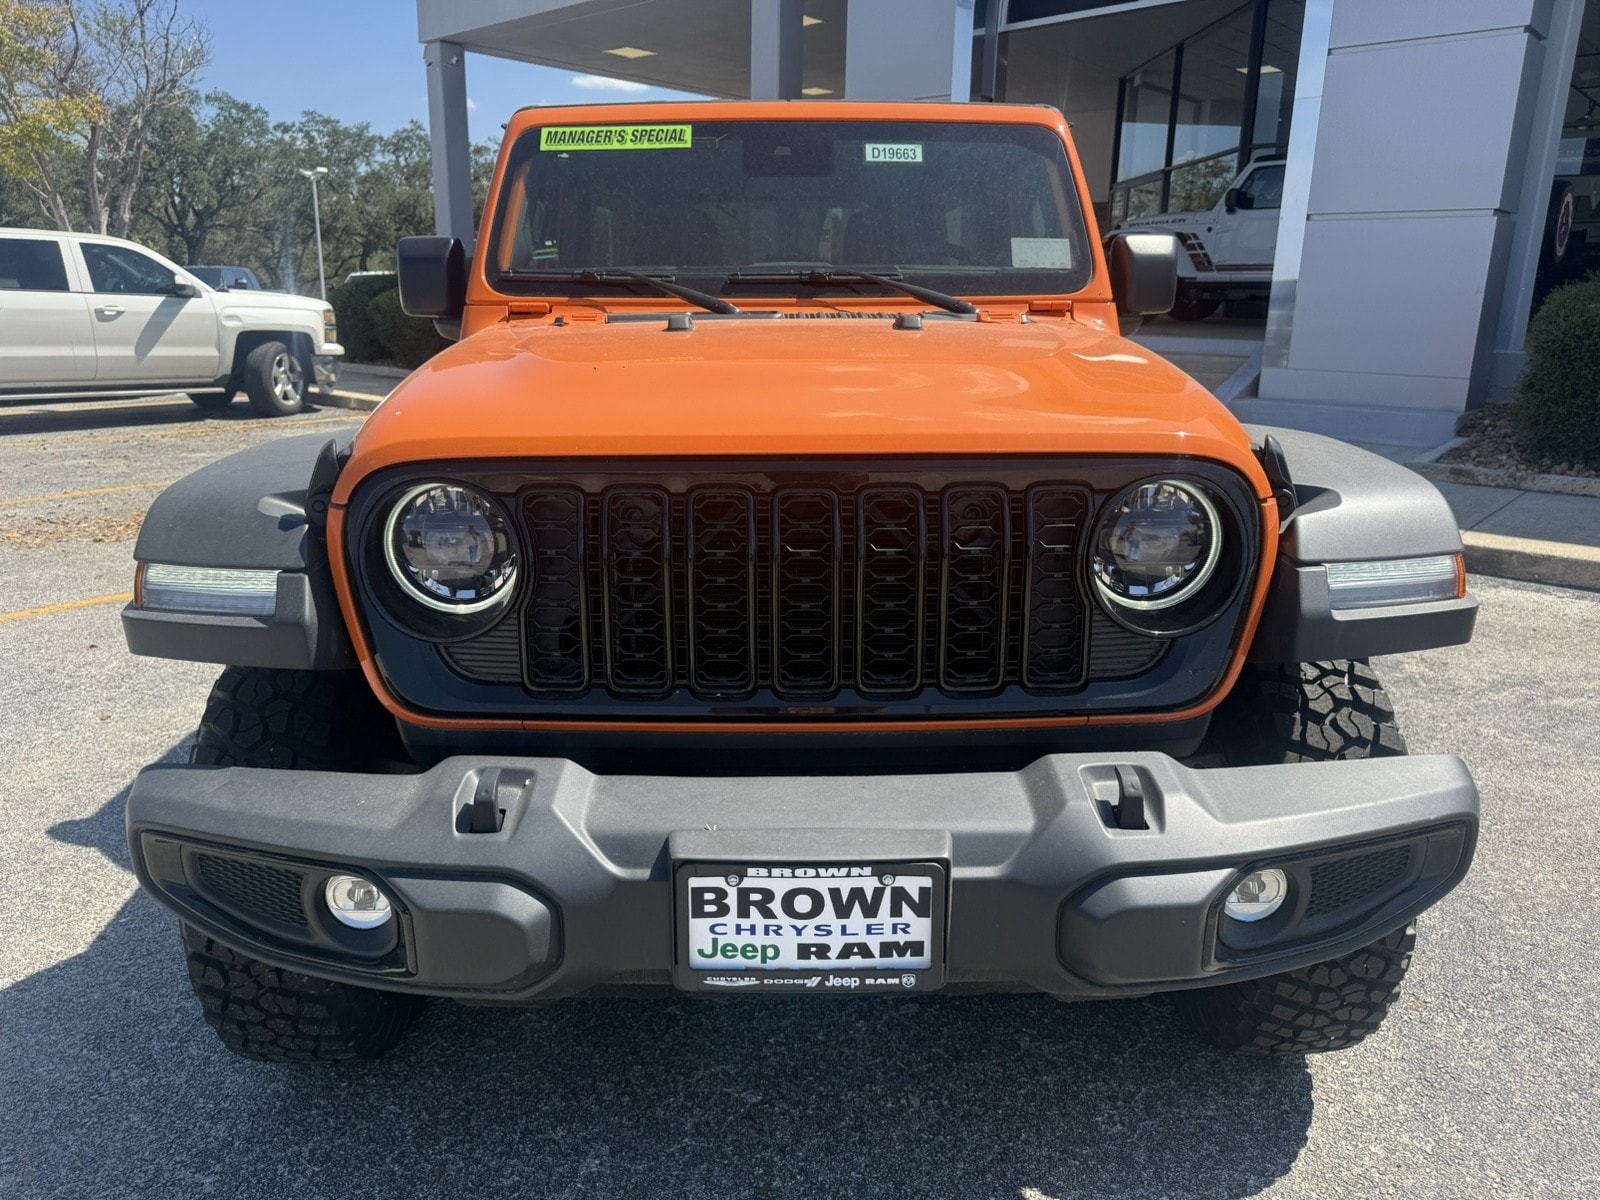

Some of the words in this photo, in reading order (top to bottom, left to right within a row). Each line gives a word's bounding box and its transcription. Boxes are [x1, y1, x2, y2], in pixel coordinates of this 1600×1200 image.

[545, 129, 628, 146] MANAGER'S
[629, 128, 688, 144] SPECIAL
[871, 147, 917, 160] D19663
[746, 866, 873, 878] BROWN
[690, 886, 932, 920] BROWN
[708, 922, 912, 937] CHRYSLER
[696, 938, 781, 964] Jeep
[796, 940, 925, 961] RAM
[824, 974, 860, 988] Jeep
